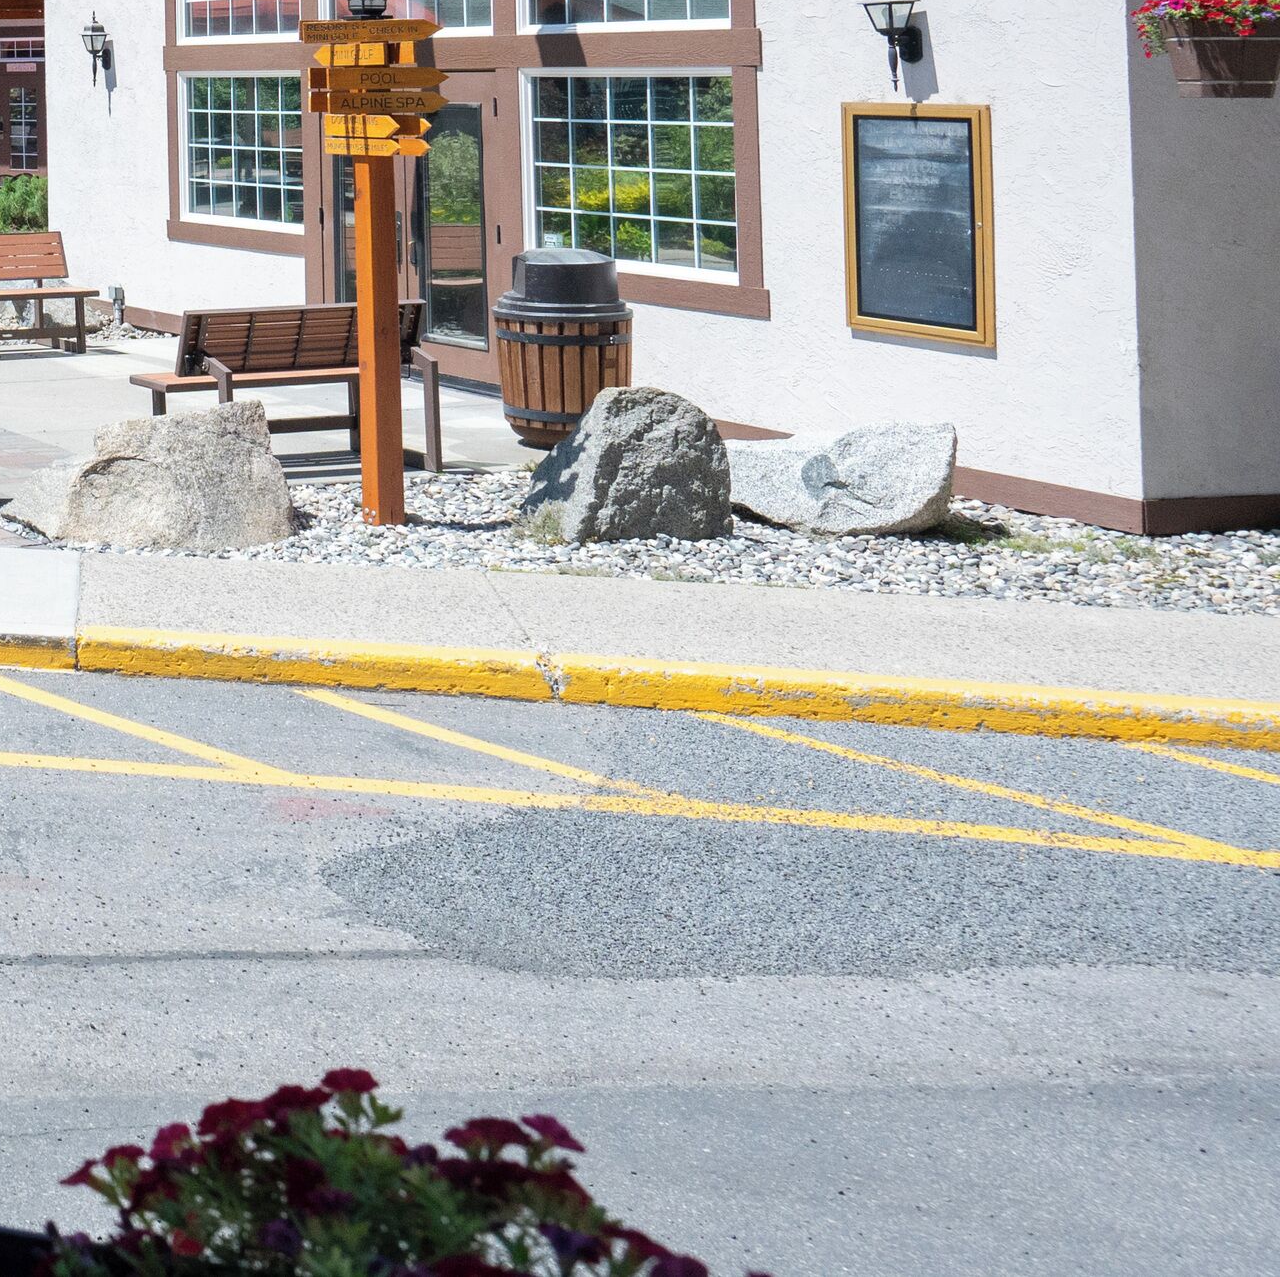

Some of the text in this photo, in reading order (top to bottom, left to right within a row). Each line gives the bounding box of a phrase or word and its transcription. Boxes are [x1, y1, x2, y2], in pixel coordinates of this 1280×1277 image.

[306, 23, 348, 32] RESORT
[369, 25, 418, 35] CHECK IN
[307, 33, 329, 41] MINI
[360, 73, 400, 84] POOL
[340, 97, 426, 109] ALPINE SPA
